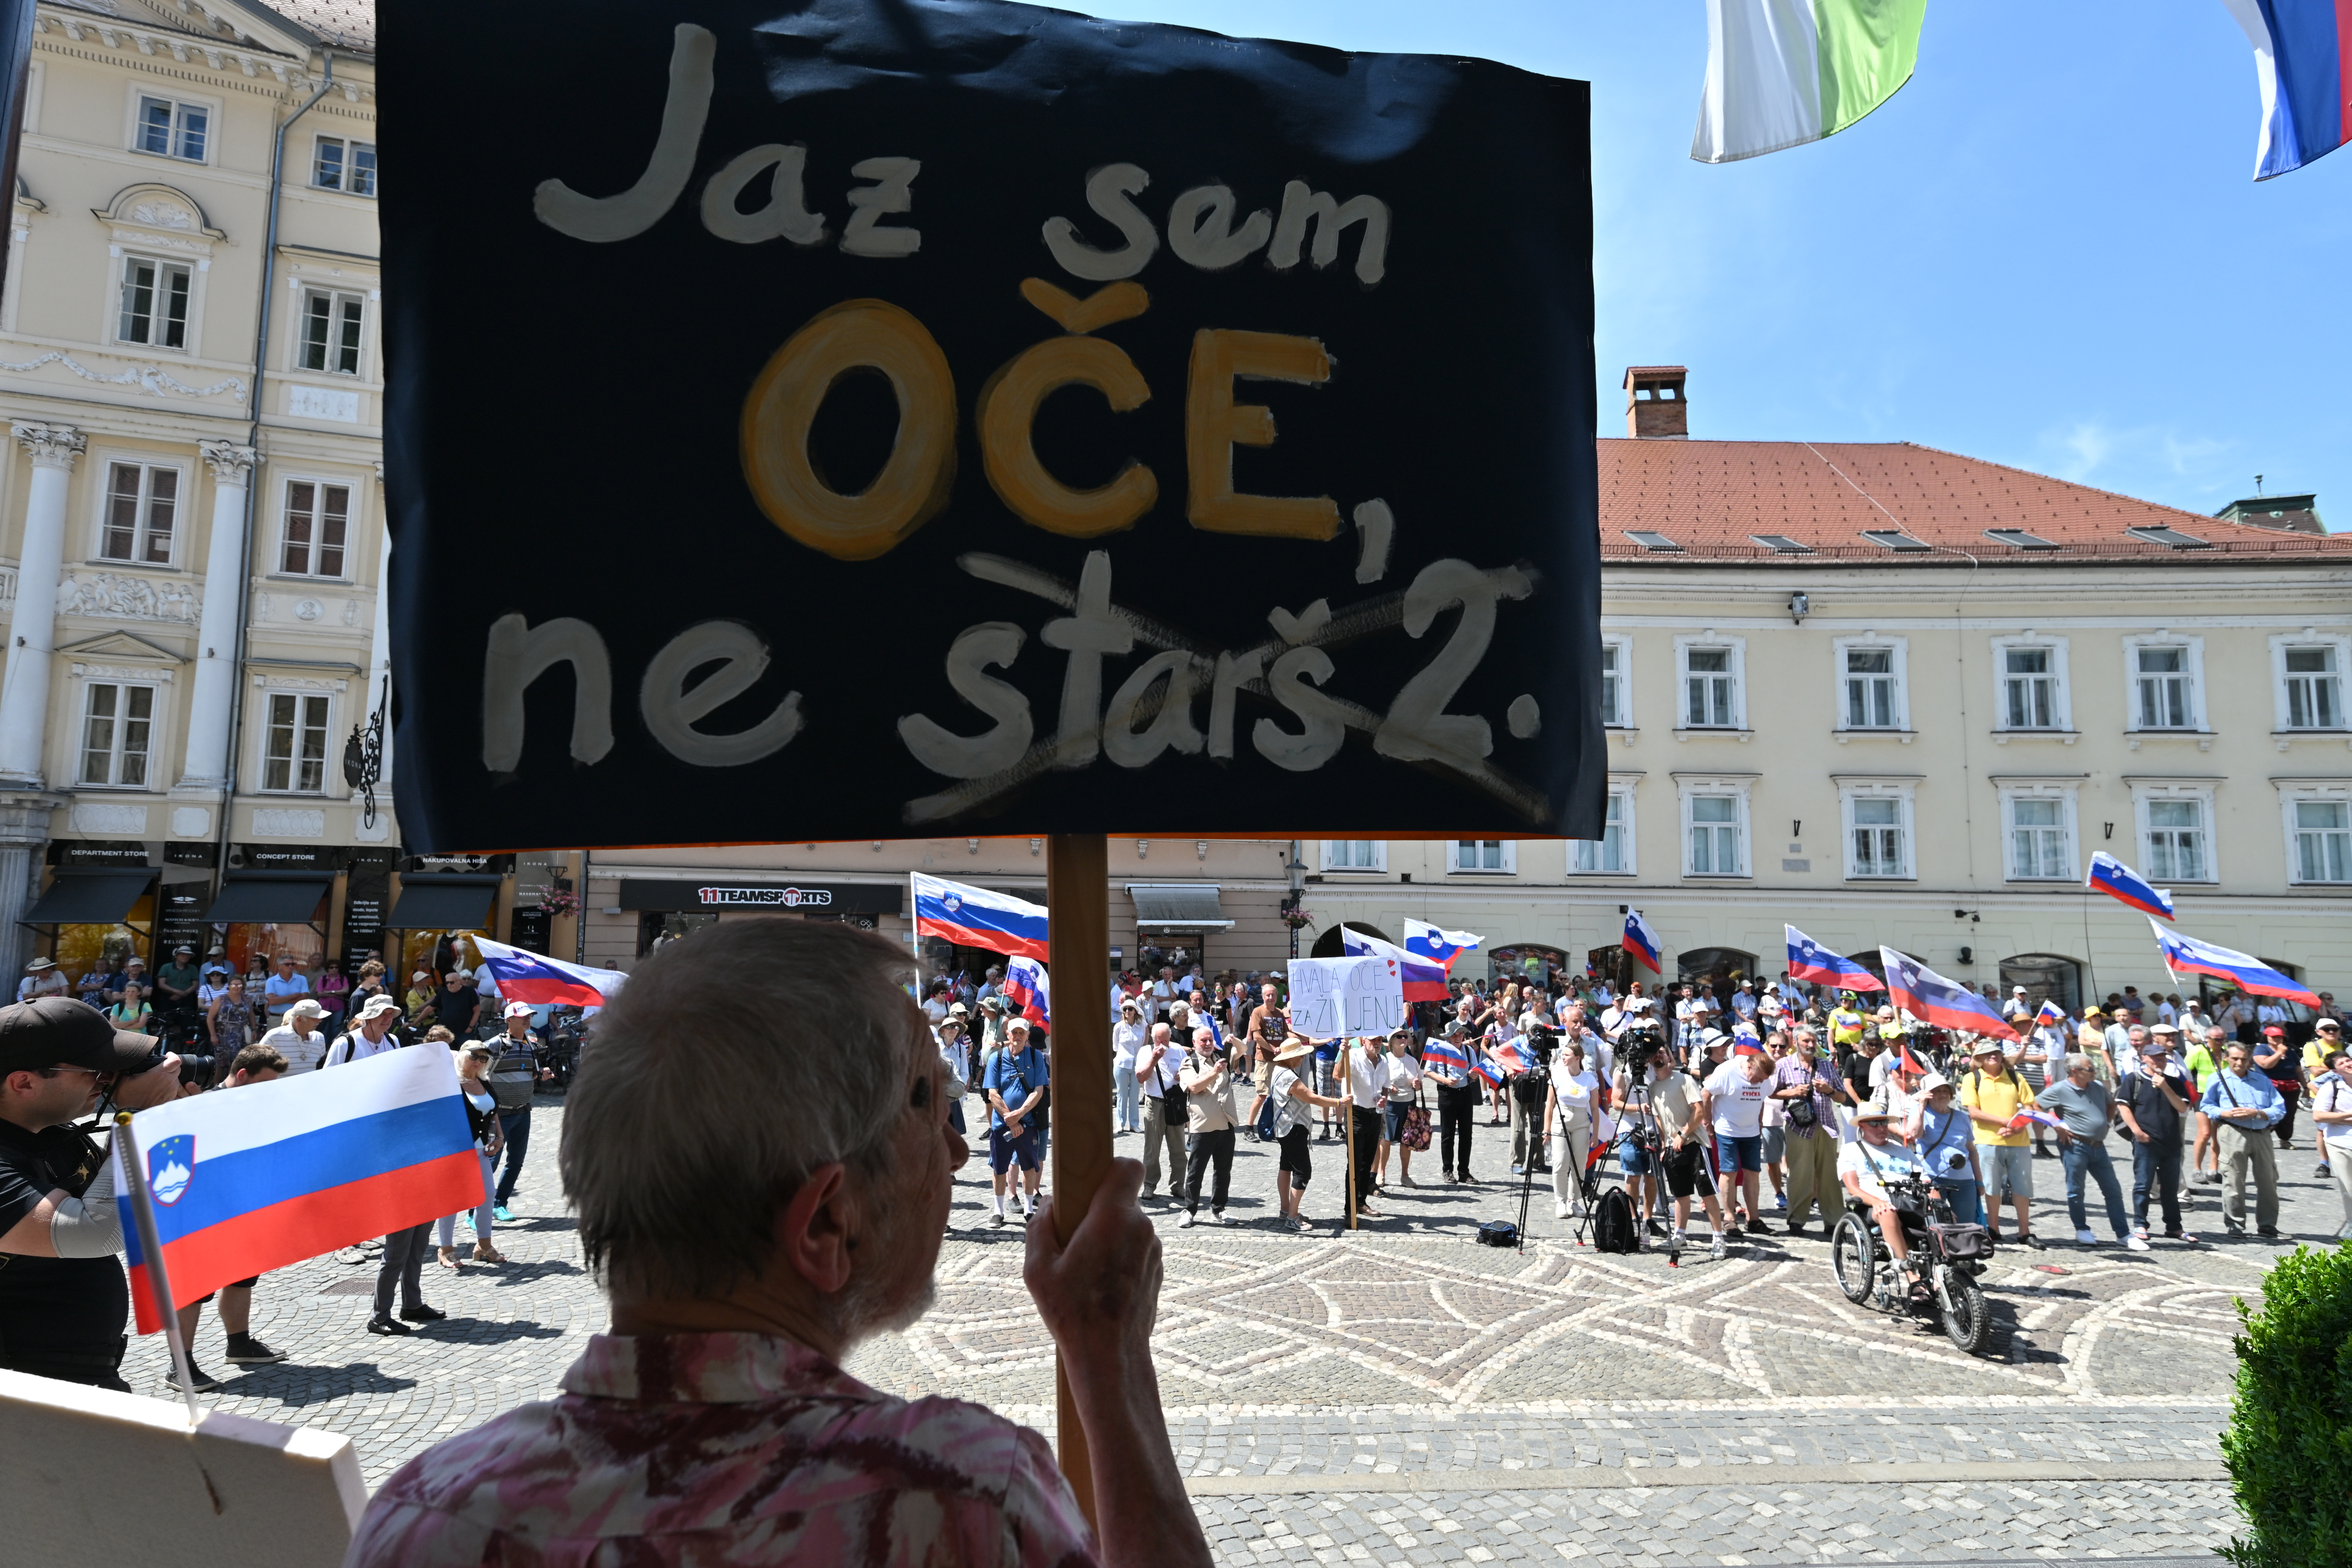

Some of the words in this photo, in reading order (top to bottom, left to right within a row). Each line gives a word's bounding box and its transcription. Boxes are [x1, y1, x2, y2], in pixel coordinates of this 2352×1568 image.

[534, 22, 921, 257] Jaz
[1042, 162, 1390, 284] sem
[740, 276, 1395, 583] OČE,
[483, 612, 806, 772] ne
[1292, 967, 1342, 994] HVALA
[1350, 962, 1385, 991] OČE
[1292, 1010, 1312, 1026] ZA
